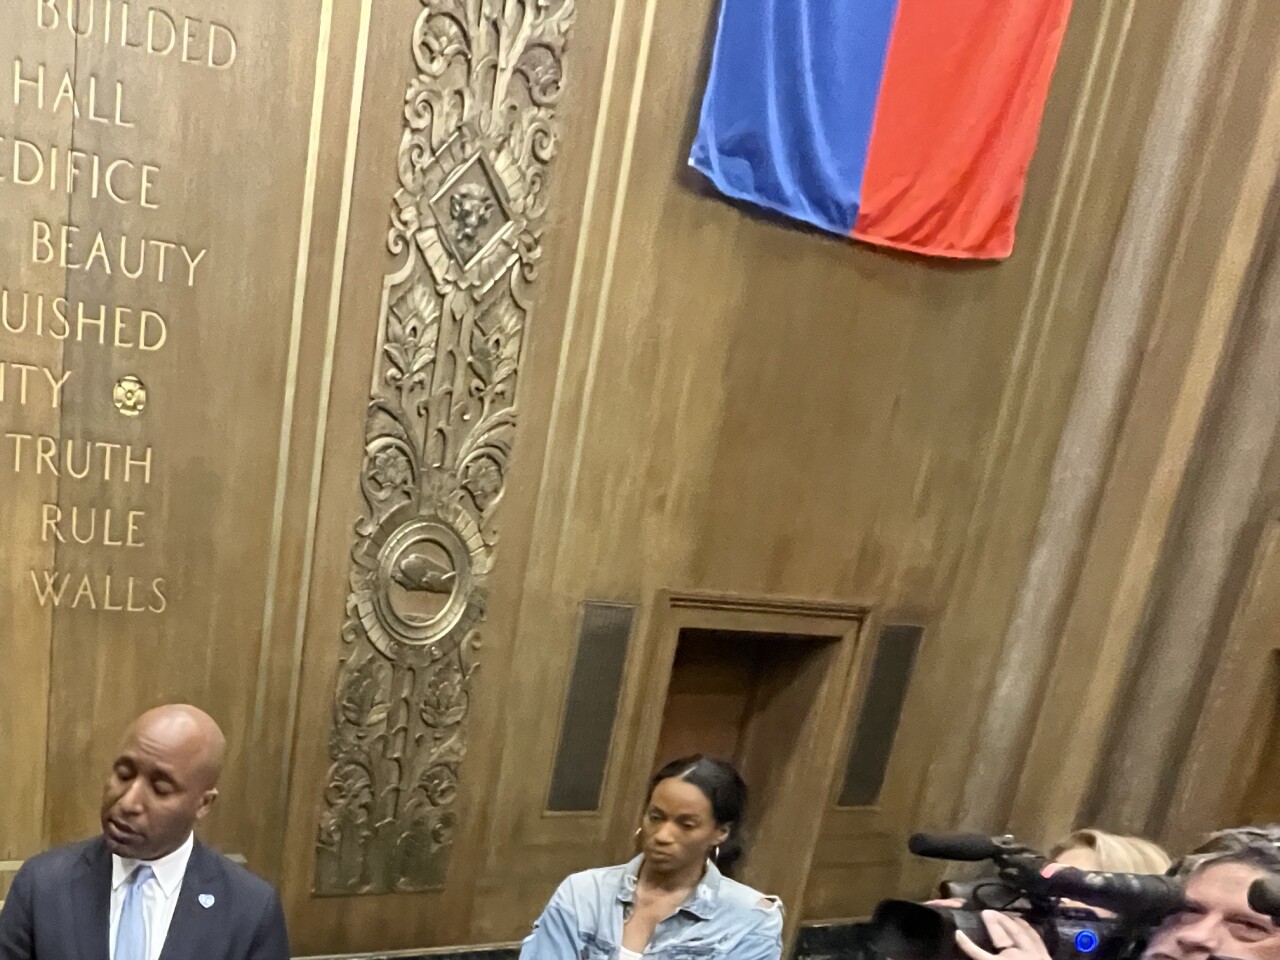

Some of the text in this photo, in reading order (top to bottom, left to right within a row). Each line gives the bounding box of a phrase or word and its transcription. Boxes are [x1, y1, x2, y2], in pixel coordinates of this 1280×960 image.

[37, 0, 237, 70] BUILDED
[13, 58, 136, 129] HALL
[31, 220, 207, 288] BEAUTY
[4, 433, 152, 485] TRUTH
[41, 504, 146, 549] RULE
[30, 570, 168, 614] WALLS
